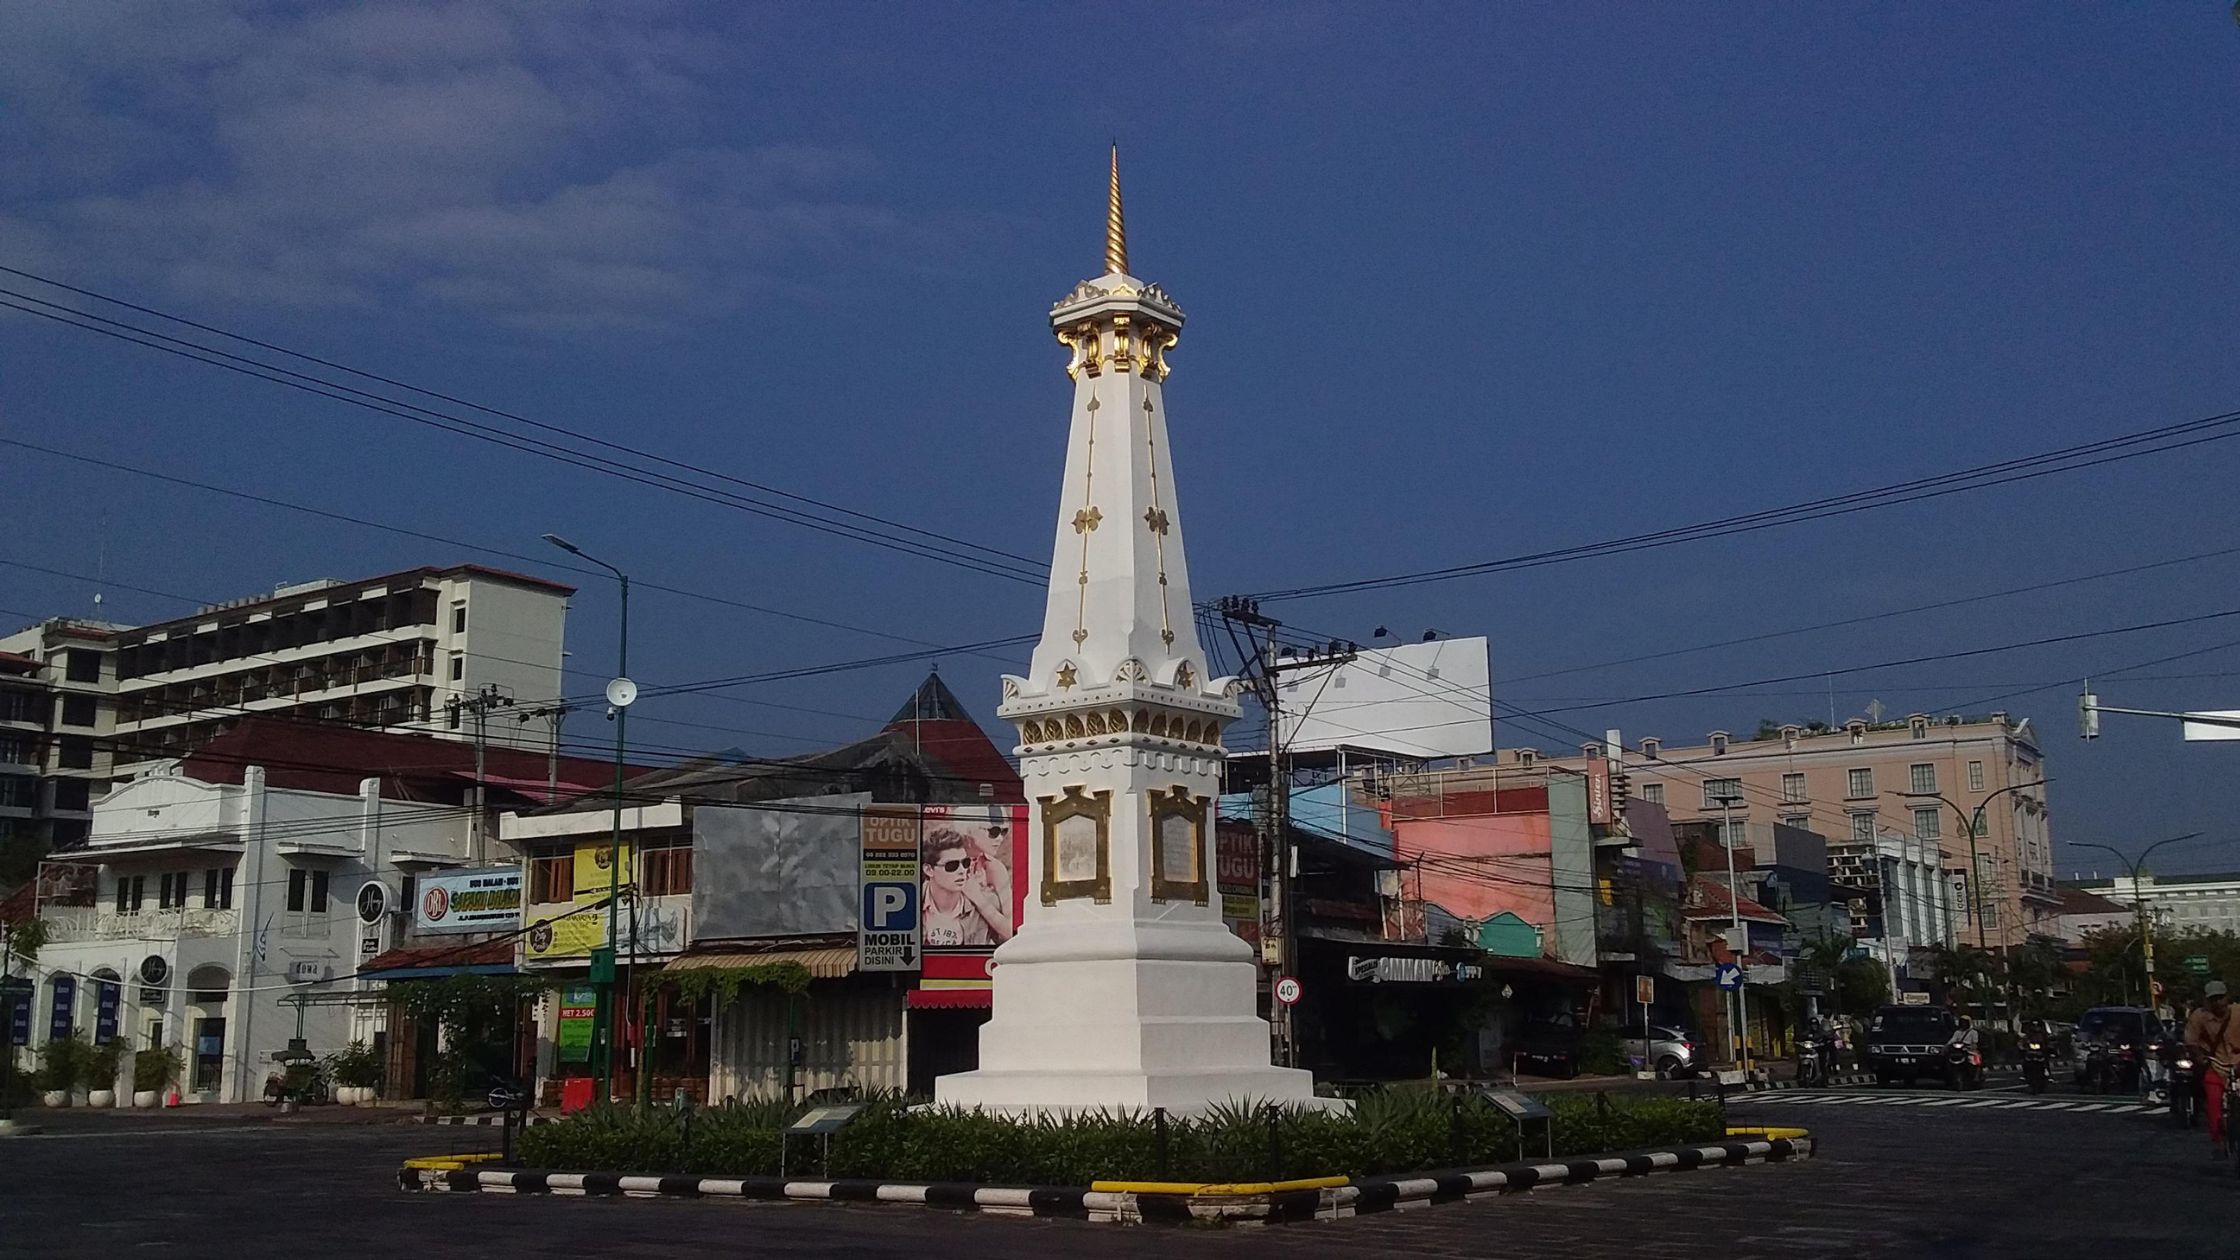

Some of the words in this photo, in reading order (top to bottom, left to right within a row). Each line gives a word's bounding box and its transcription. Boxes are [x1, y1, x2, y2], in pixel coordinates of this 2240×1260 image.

[869, 816, 912, 827] OPTIK
[865, 828, 916, 842] TUGU
[1216, 832, 1254, 854] PTIK
[1217, 856, 1254, 878] UGU
[427, 890, 444, 916] OBL
[873, 886, 907, 927] P
[864, 933, 916, 946] MOBIL
[864, 946, 903, 956] PARKIR
[864, 956, 895, 966] DISINI
[1279, 985, 1293, 996] 40
